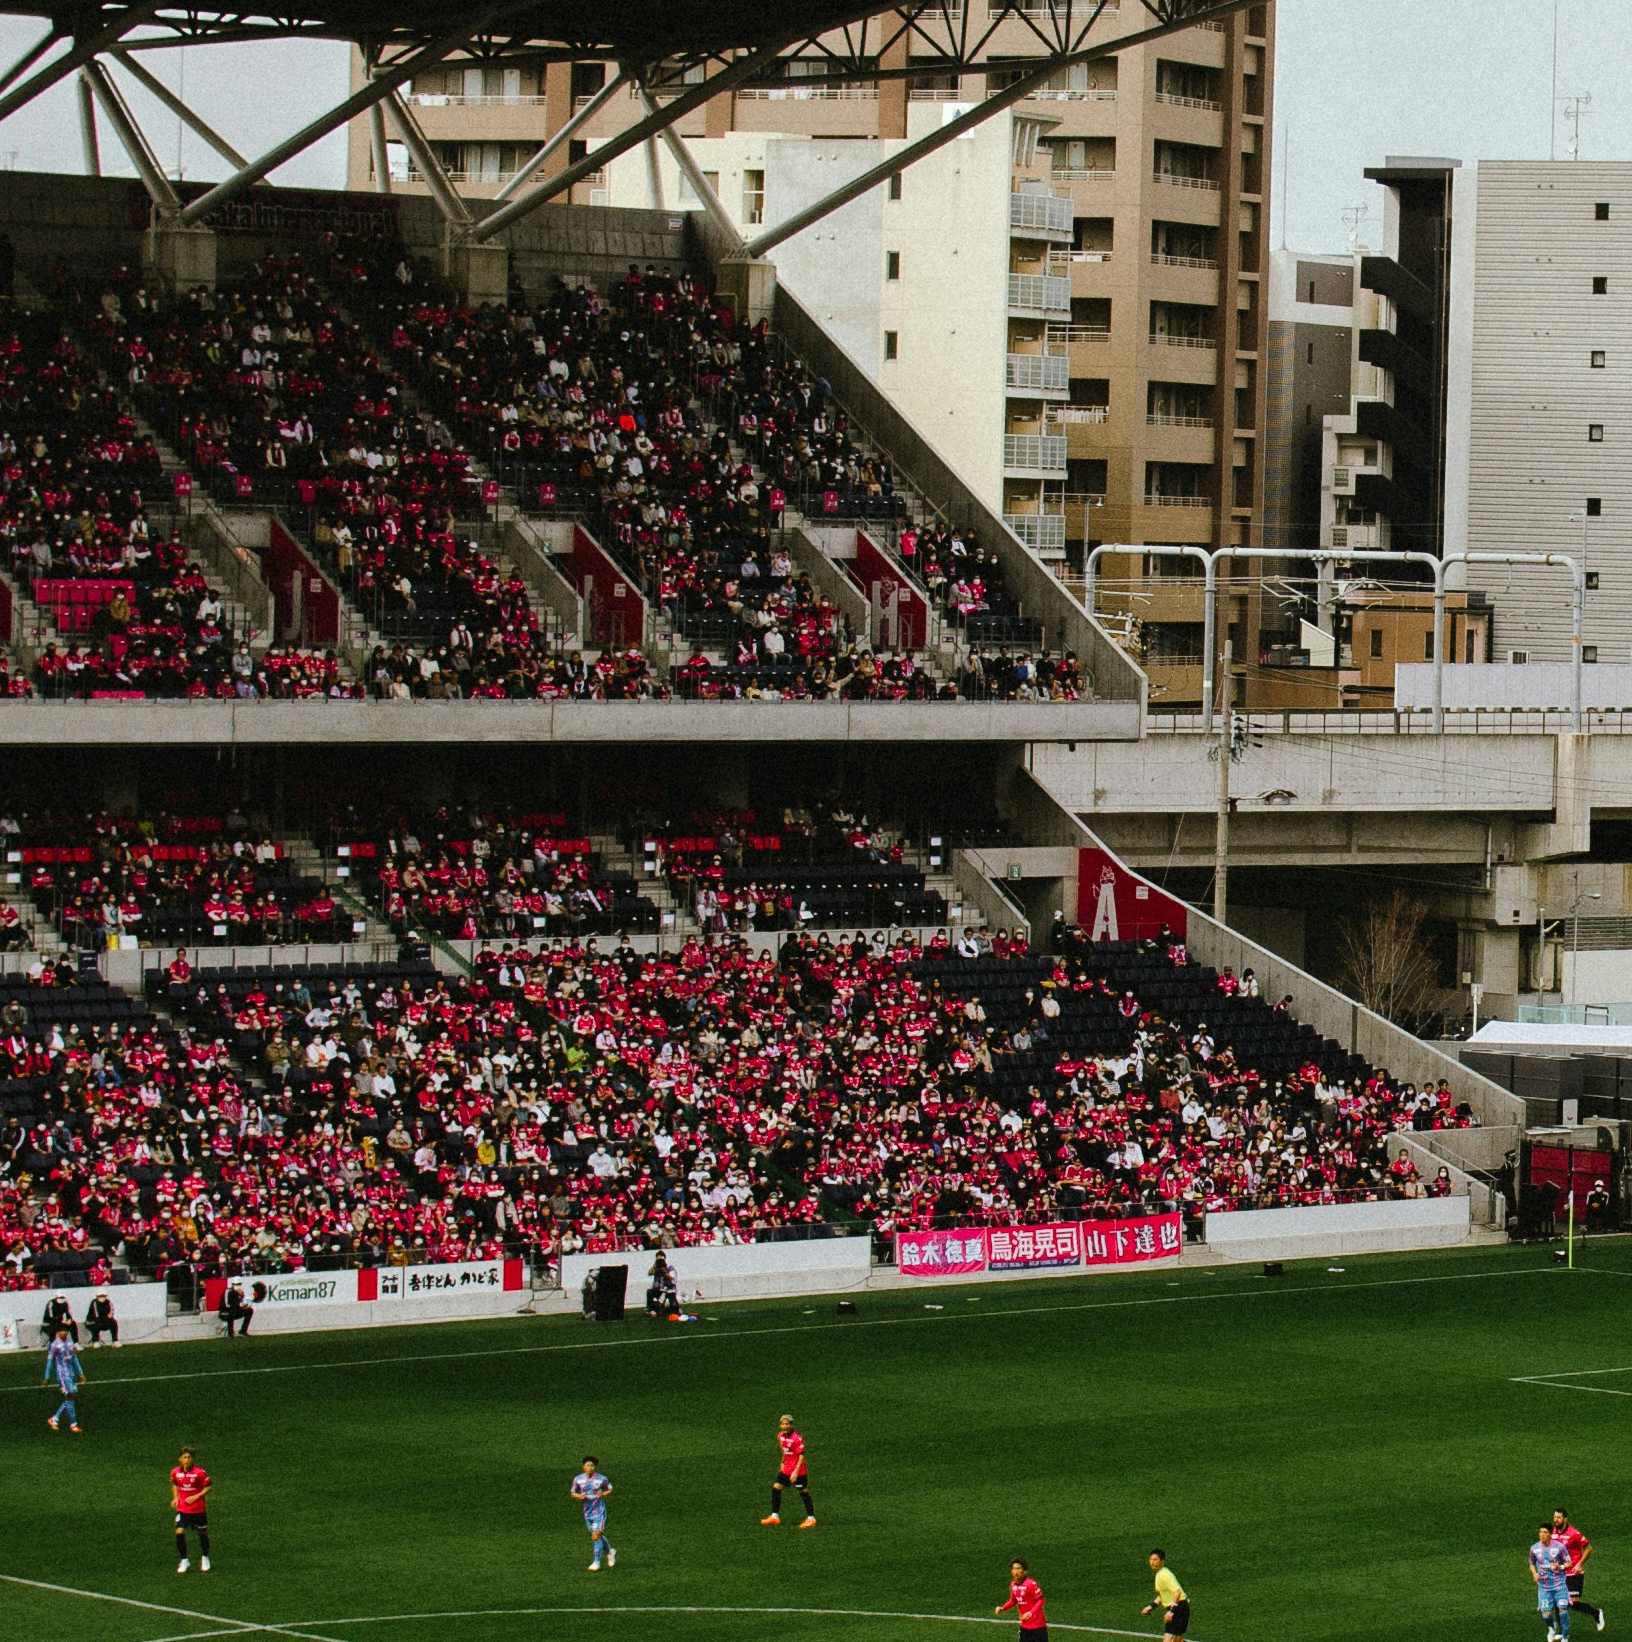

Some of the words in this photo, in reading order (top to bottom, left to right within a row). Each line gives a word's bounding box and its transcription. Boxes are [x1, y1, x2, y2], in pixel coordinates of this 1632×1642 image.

[990, 1227, 1078, 1261] 鳥海晃司
[1087, 1220, 1180, 1259] 山下達也
[268, 1280, 337, 1301] Kemari87
